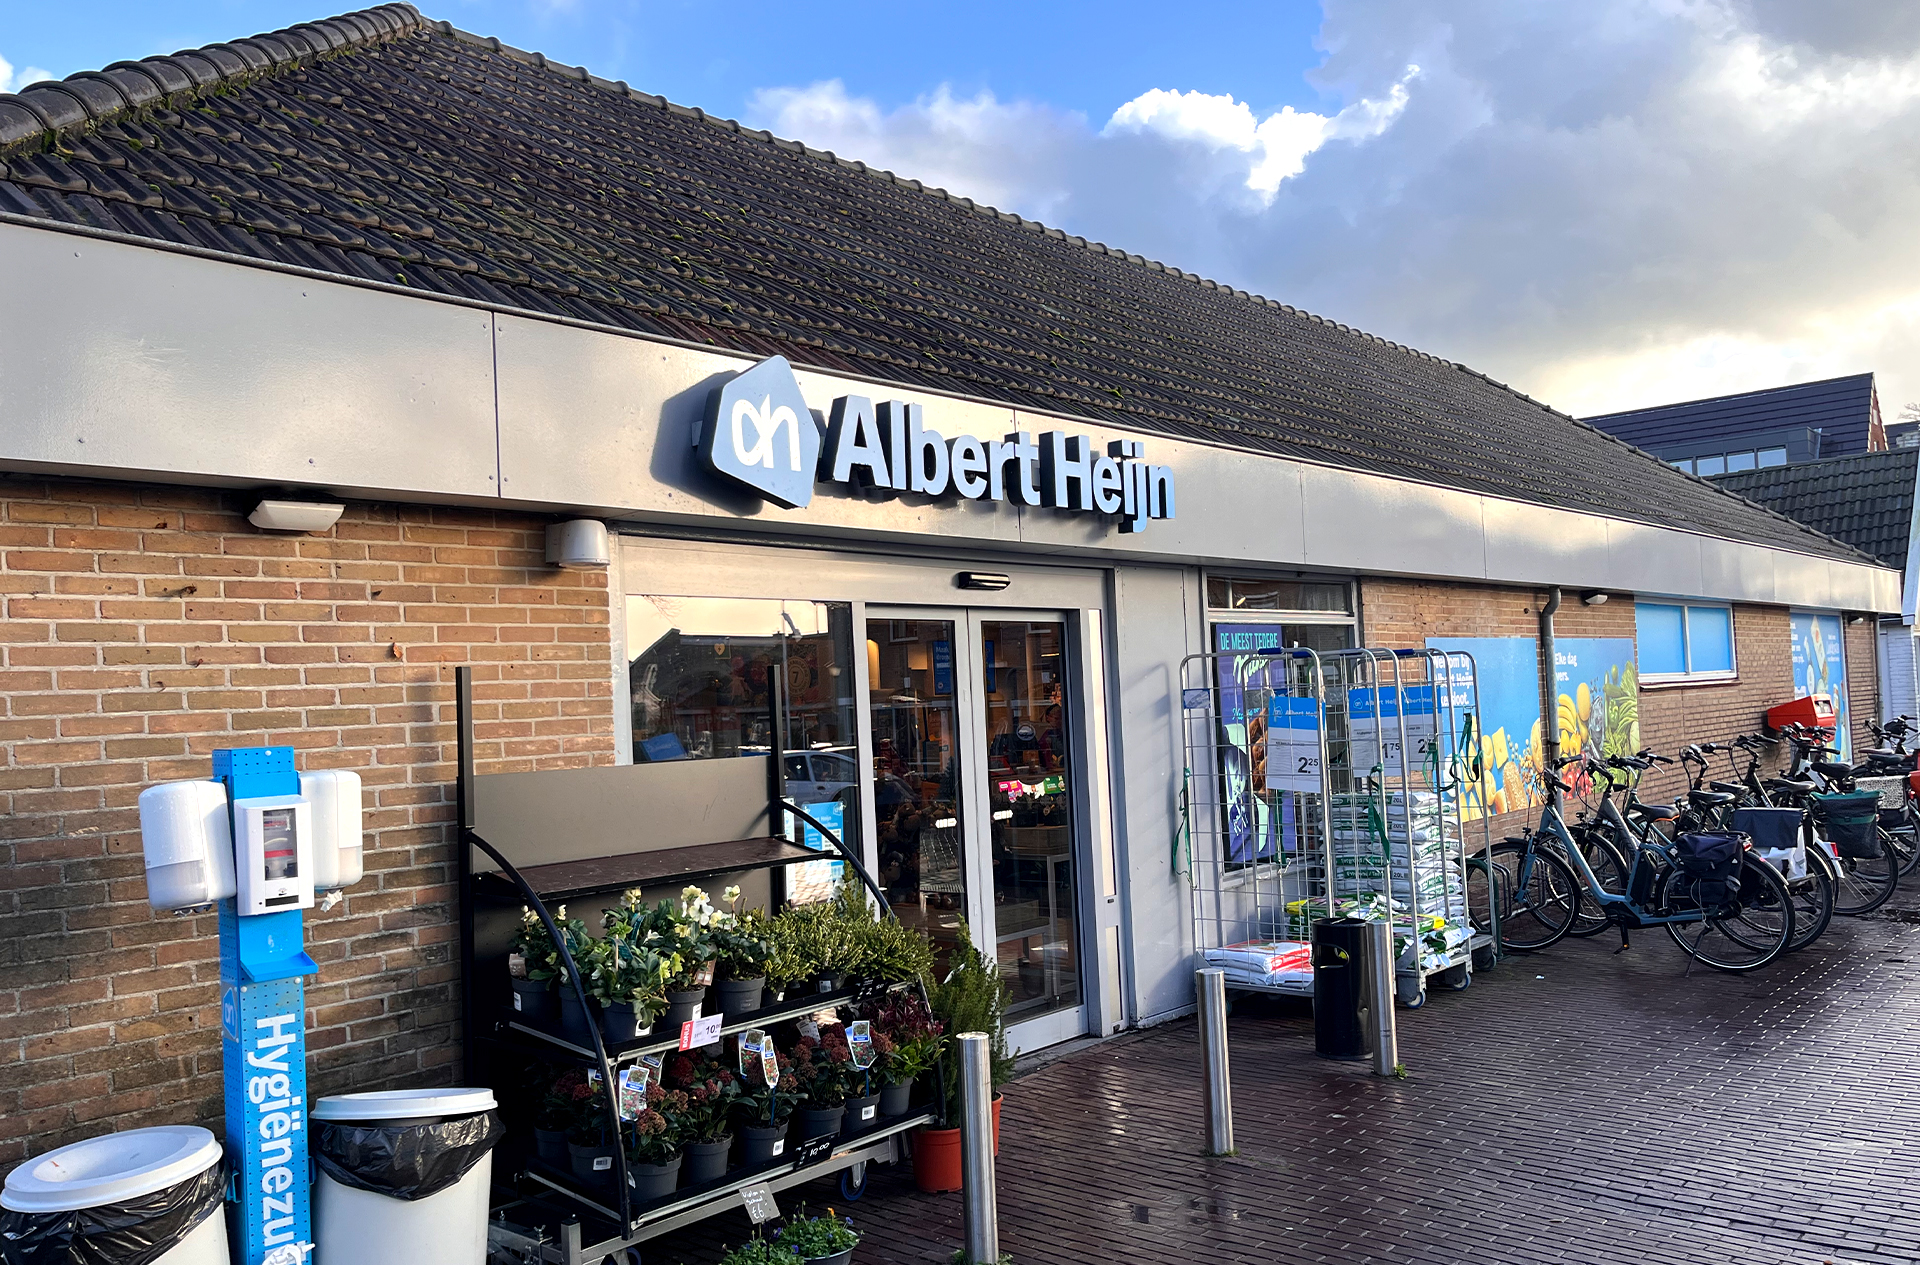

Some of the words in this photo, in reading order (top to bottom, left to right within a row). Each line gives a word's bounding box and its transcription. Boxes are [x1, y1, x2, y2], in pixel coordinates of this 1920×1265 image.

[828, 395, 1041, 507] Albert
[1052, 430, 1177, 534] Heijn
[1220, 632, 1230, 651] DE
[1231, 632, 1253, 651] MEEST
[1431, 655, 1460, 669] Welom
